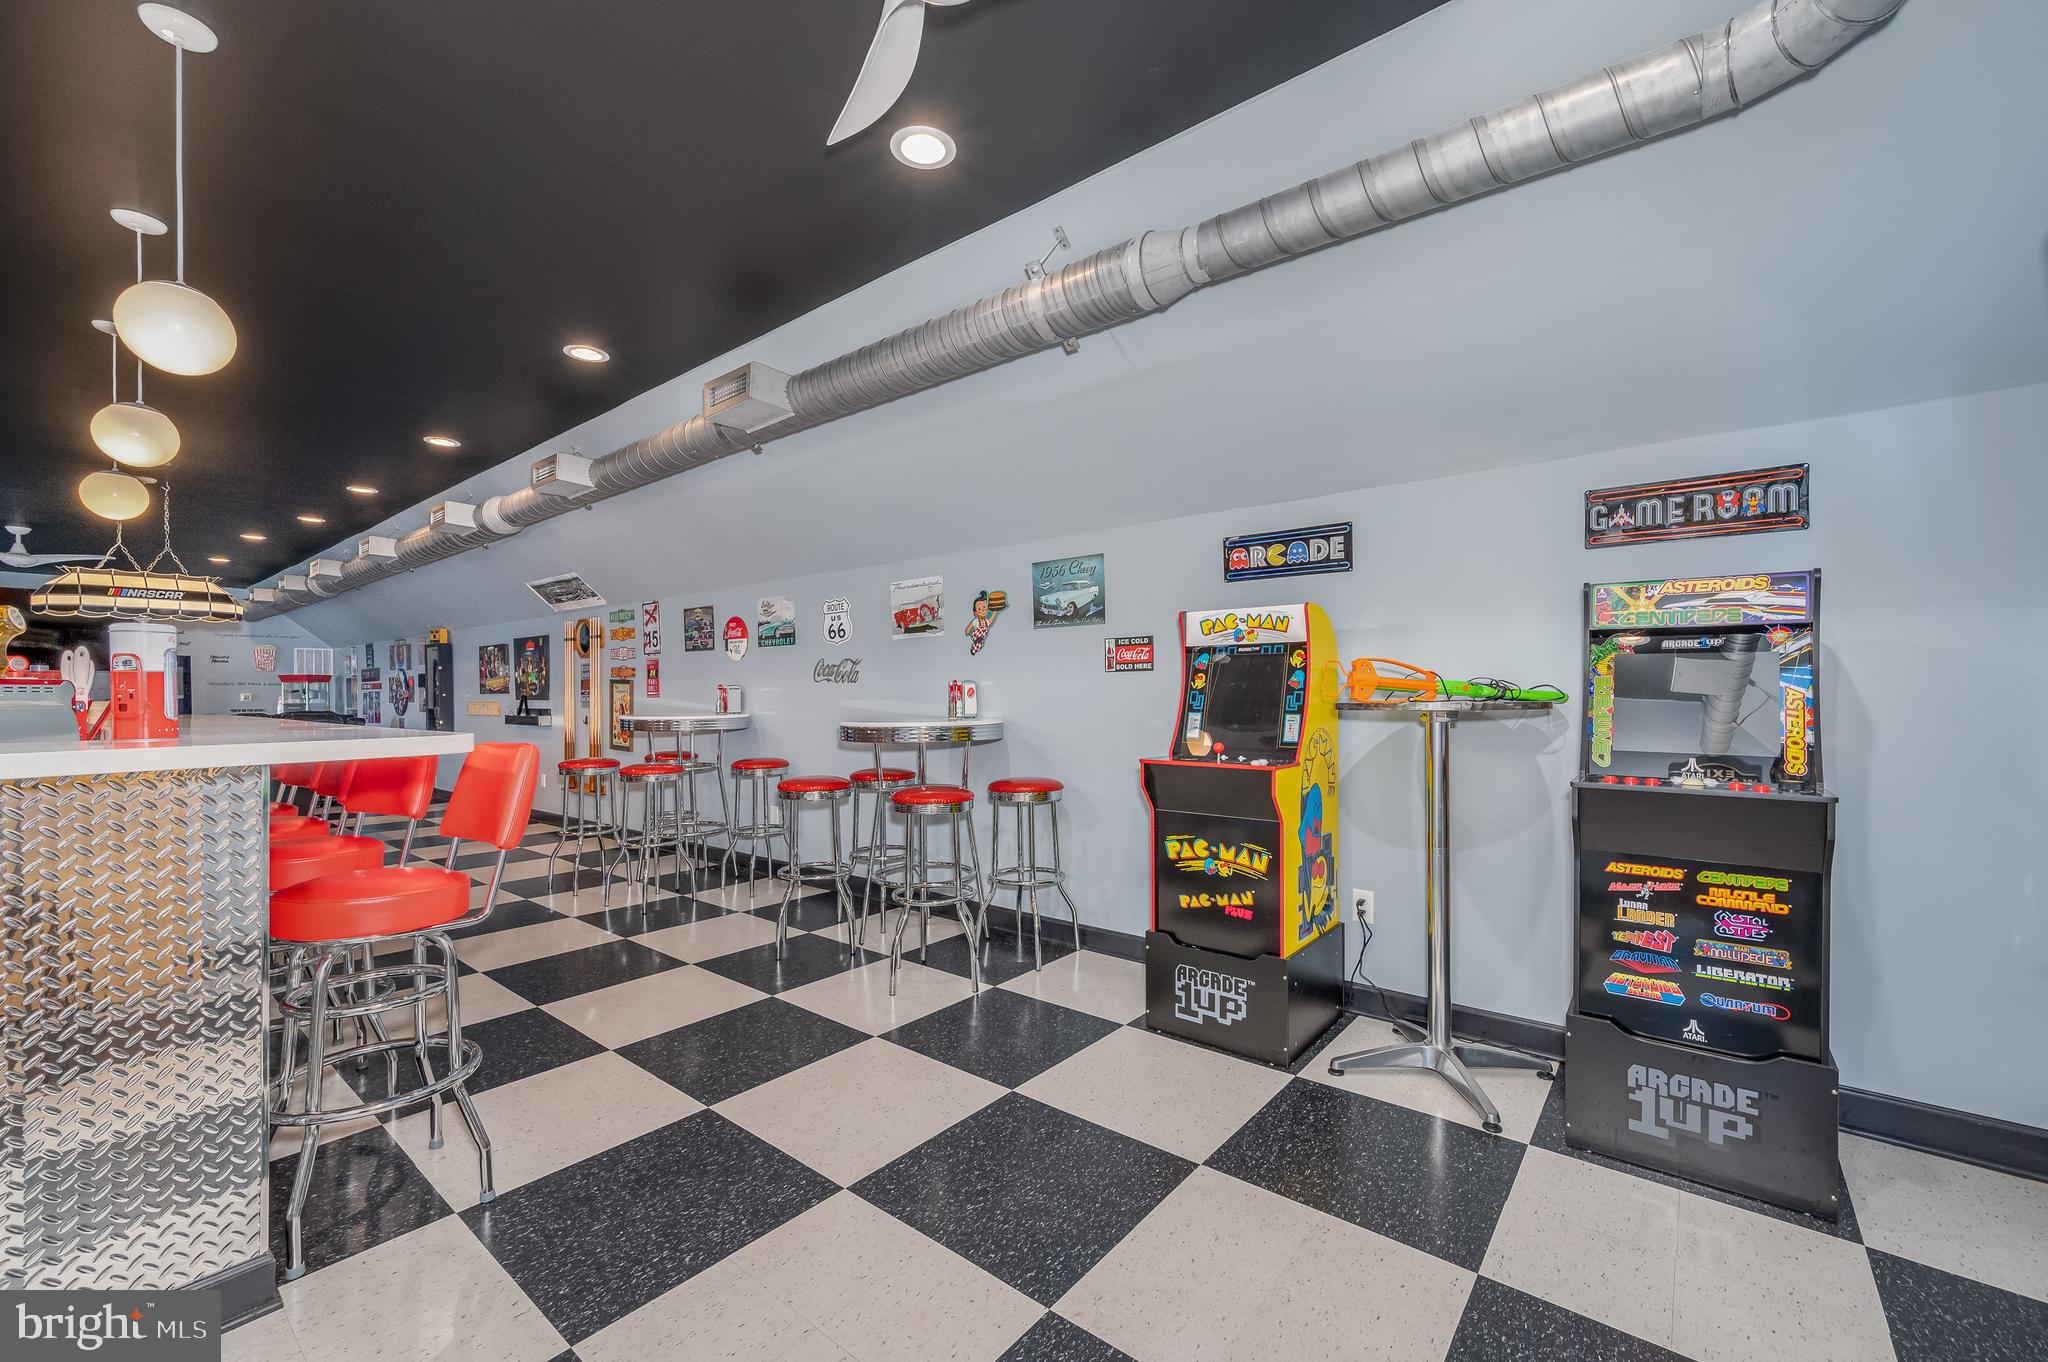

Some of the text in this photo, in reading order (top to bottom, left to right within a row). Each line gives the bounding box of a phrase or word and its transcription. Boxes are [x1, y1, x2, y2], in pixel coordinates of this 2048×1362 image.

[1589, 495, 1685, 531] GAME
[1229, 536, 1345, 571] ARCADE
[1040, 560, 1097, 579] 1956 Chevy
[126, 589, 184, 600] NASCAR
[1659, 575, 1772, 595] ASTEROIDS
[827, 603, 844, 611] ROUTE
[1618, 608, 1743, 626] CENTIPEDE
[828, 623, 846, 639] 66
[1200, 613, 1290, 636] PAC-MAN
[760, 638, 794, 647] CHEVROLET
[1117, 647, 1151, 661] Coca-Cola
[813, 658, 862, 683] Coca-Cola
[1592, 675, 1614, 768] CENTIPEDE
[1783, 685, 1808, 776] ASTEROIDS
[1681, 772, 1704, 780] ATARI
[1165, 837, 1272, 874] PAC-MAN
[1605, 862, 1685, 880] ASTEROIDS
[1697, 870, 1789, 892] CENTIPEDE
[1179, 891, 1255, 908] PAC-MAN
[1619, 898, 1648, 910] LUNAR
[1696, 894, 1790, 915] COMMAND
[1708, 887, 1776, 904] MISSILE
[1224, 906, 1254, 921] PLUS
[1617, 904, 1675, 928] LANDER
[1175, 964, 1248, 997] ARCADE
[1696, 964, 1791, 988] LIBERATOR
[1175, 981, 1247, 1026] 1UP
[1700, 992, 1777, 1017] QUANTUM
[1682, 1032, 1706, 1042] ATARI
[1627, 1063, 1759, 1116] ARCADE
[1628, 1086, 1753, 1145] 1UP
